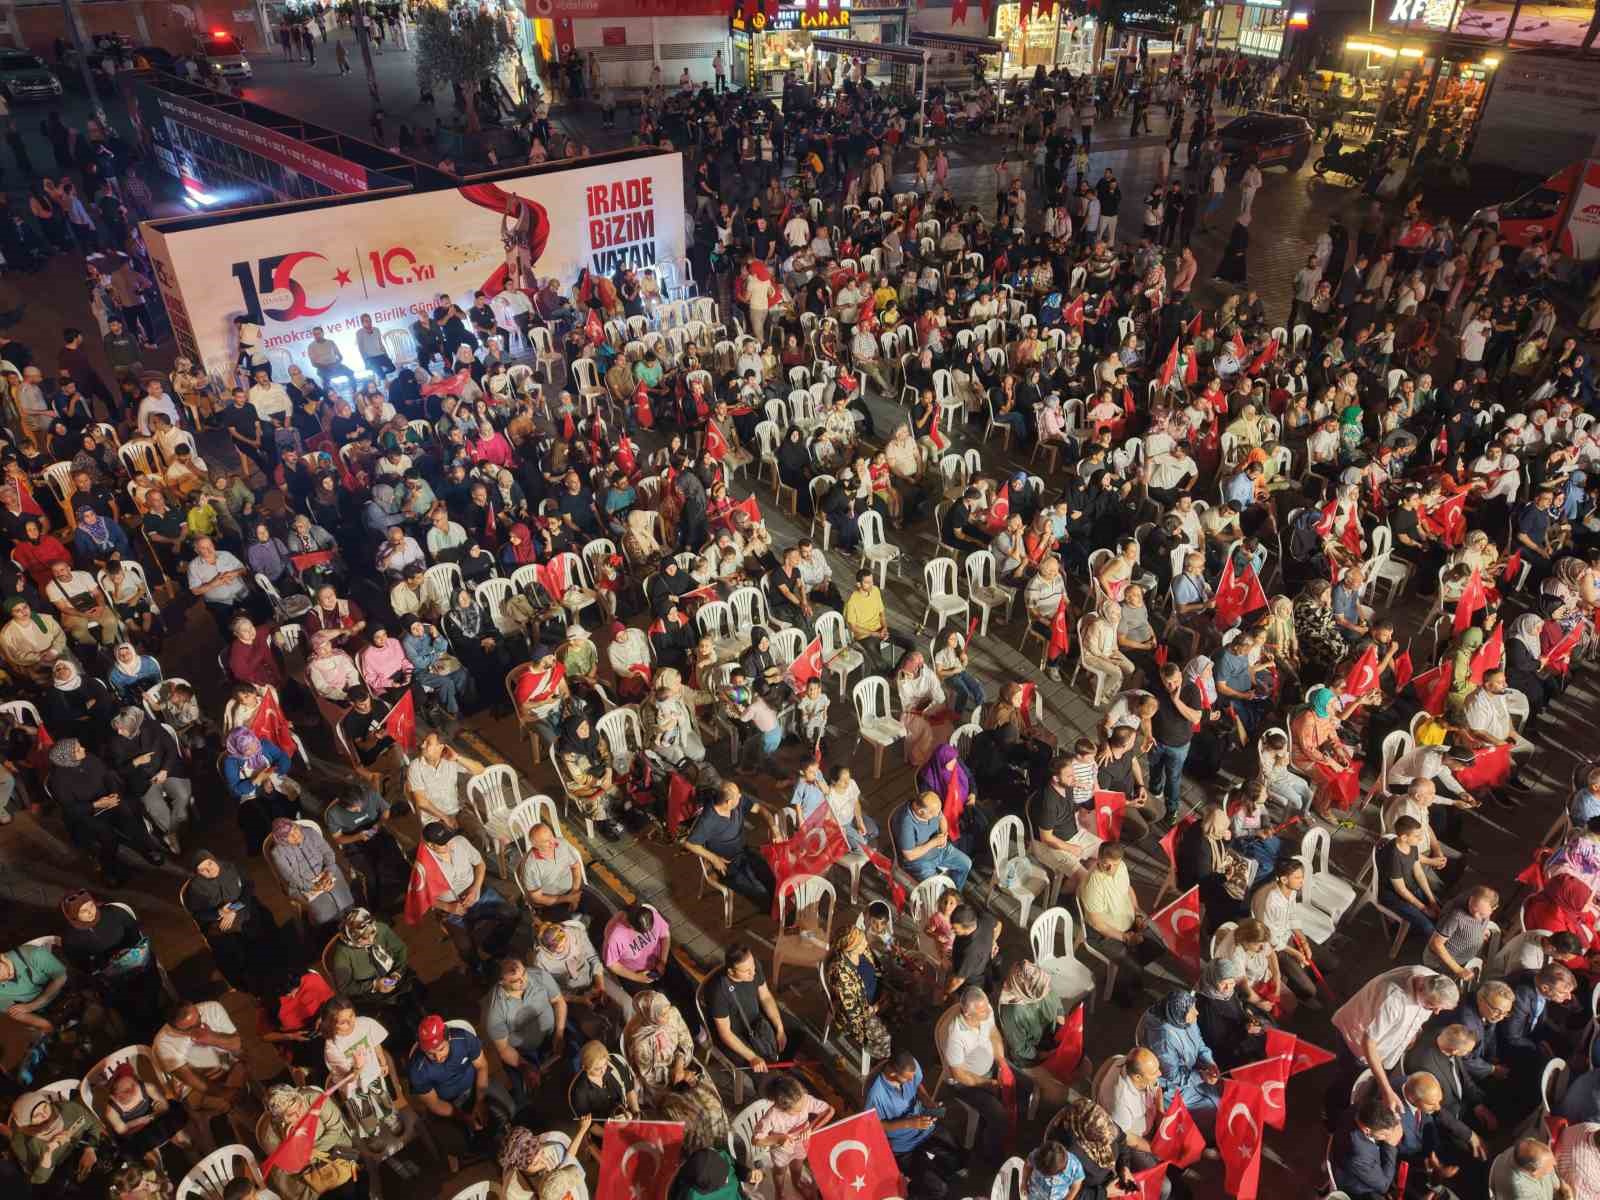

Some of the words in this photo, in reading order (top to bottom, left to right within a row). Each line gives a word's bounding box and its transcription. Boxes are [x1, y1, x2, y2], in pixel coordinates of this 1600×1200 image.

[586, 177, 654, 217] İRADE
[589, 209, 655, 250] BİZİM
[592, 241, 656, 275] VATAN
